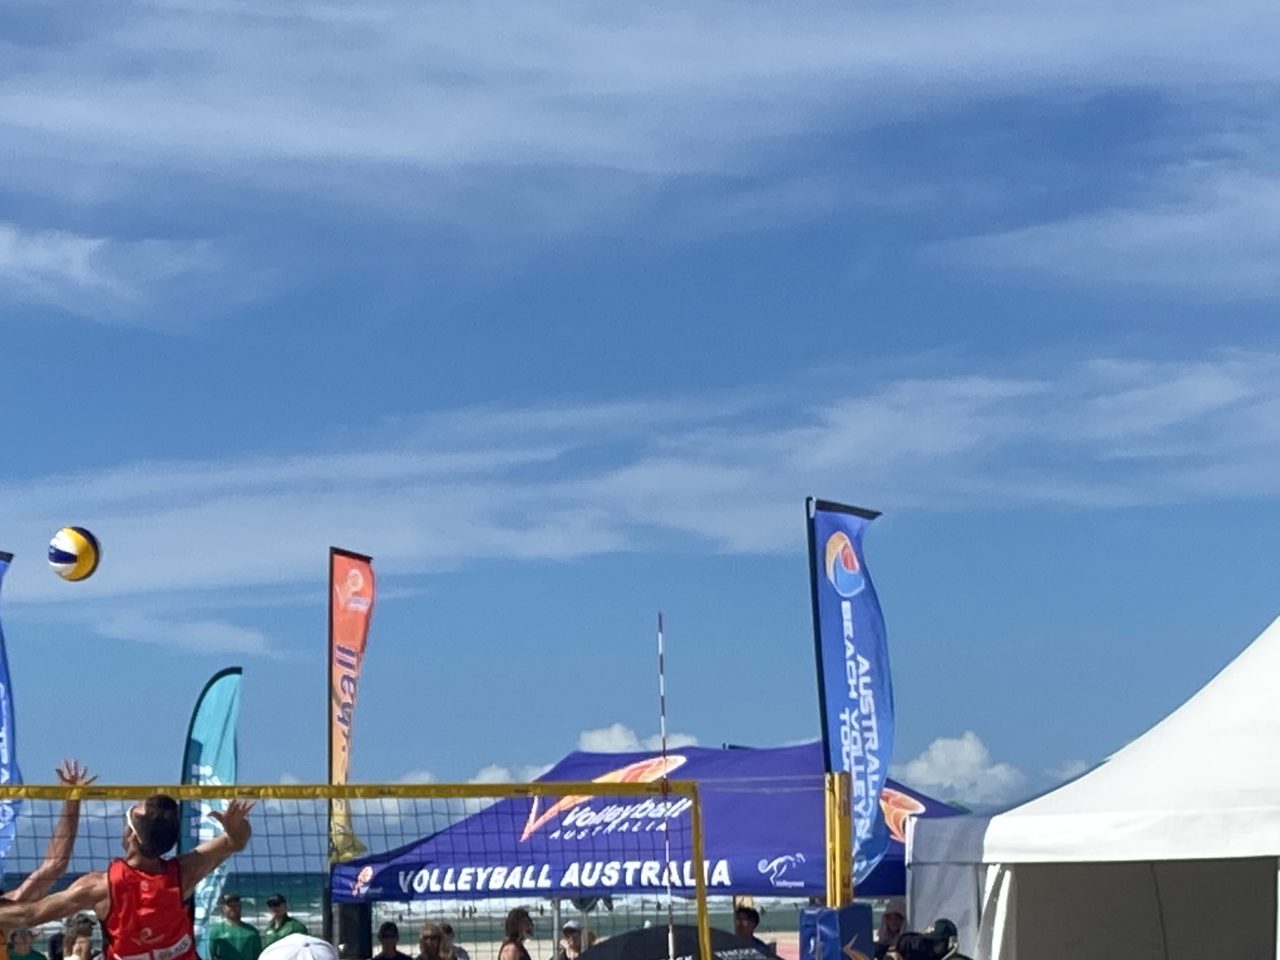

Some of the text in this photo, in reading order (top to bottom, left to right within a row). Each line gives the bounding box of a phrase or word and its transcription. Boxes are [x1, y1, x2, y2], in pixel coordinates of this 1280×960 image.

[841, 601, 858, 699] BEACH
[562, 798, 693, 827] Volleyball
[549, 820, 667, 840] AUSTRALIA
[398, 864, 552, 893] VOLLEYBALL
